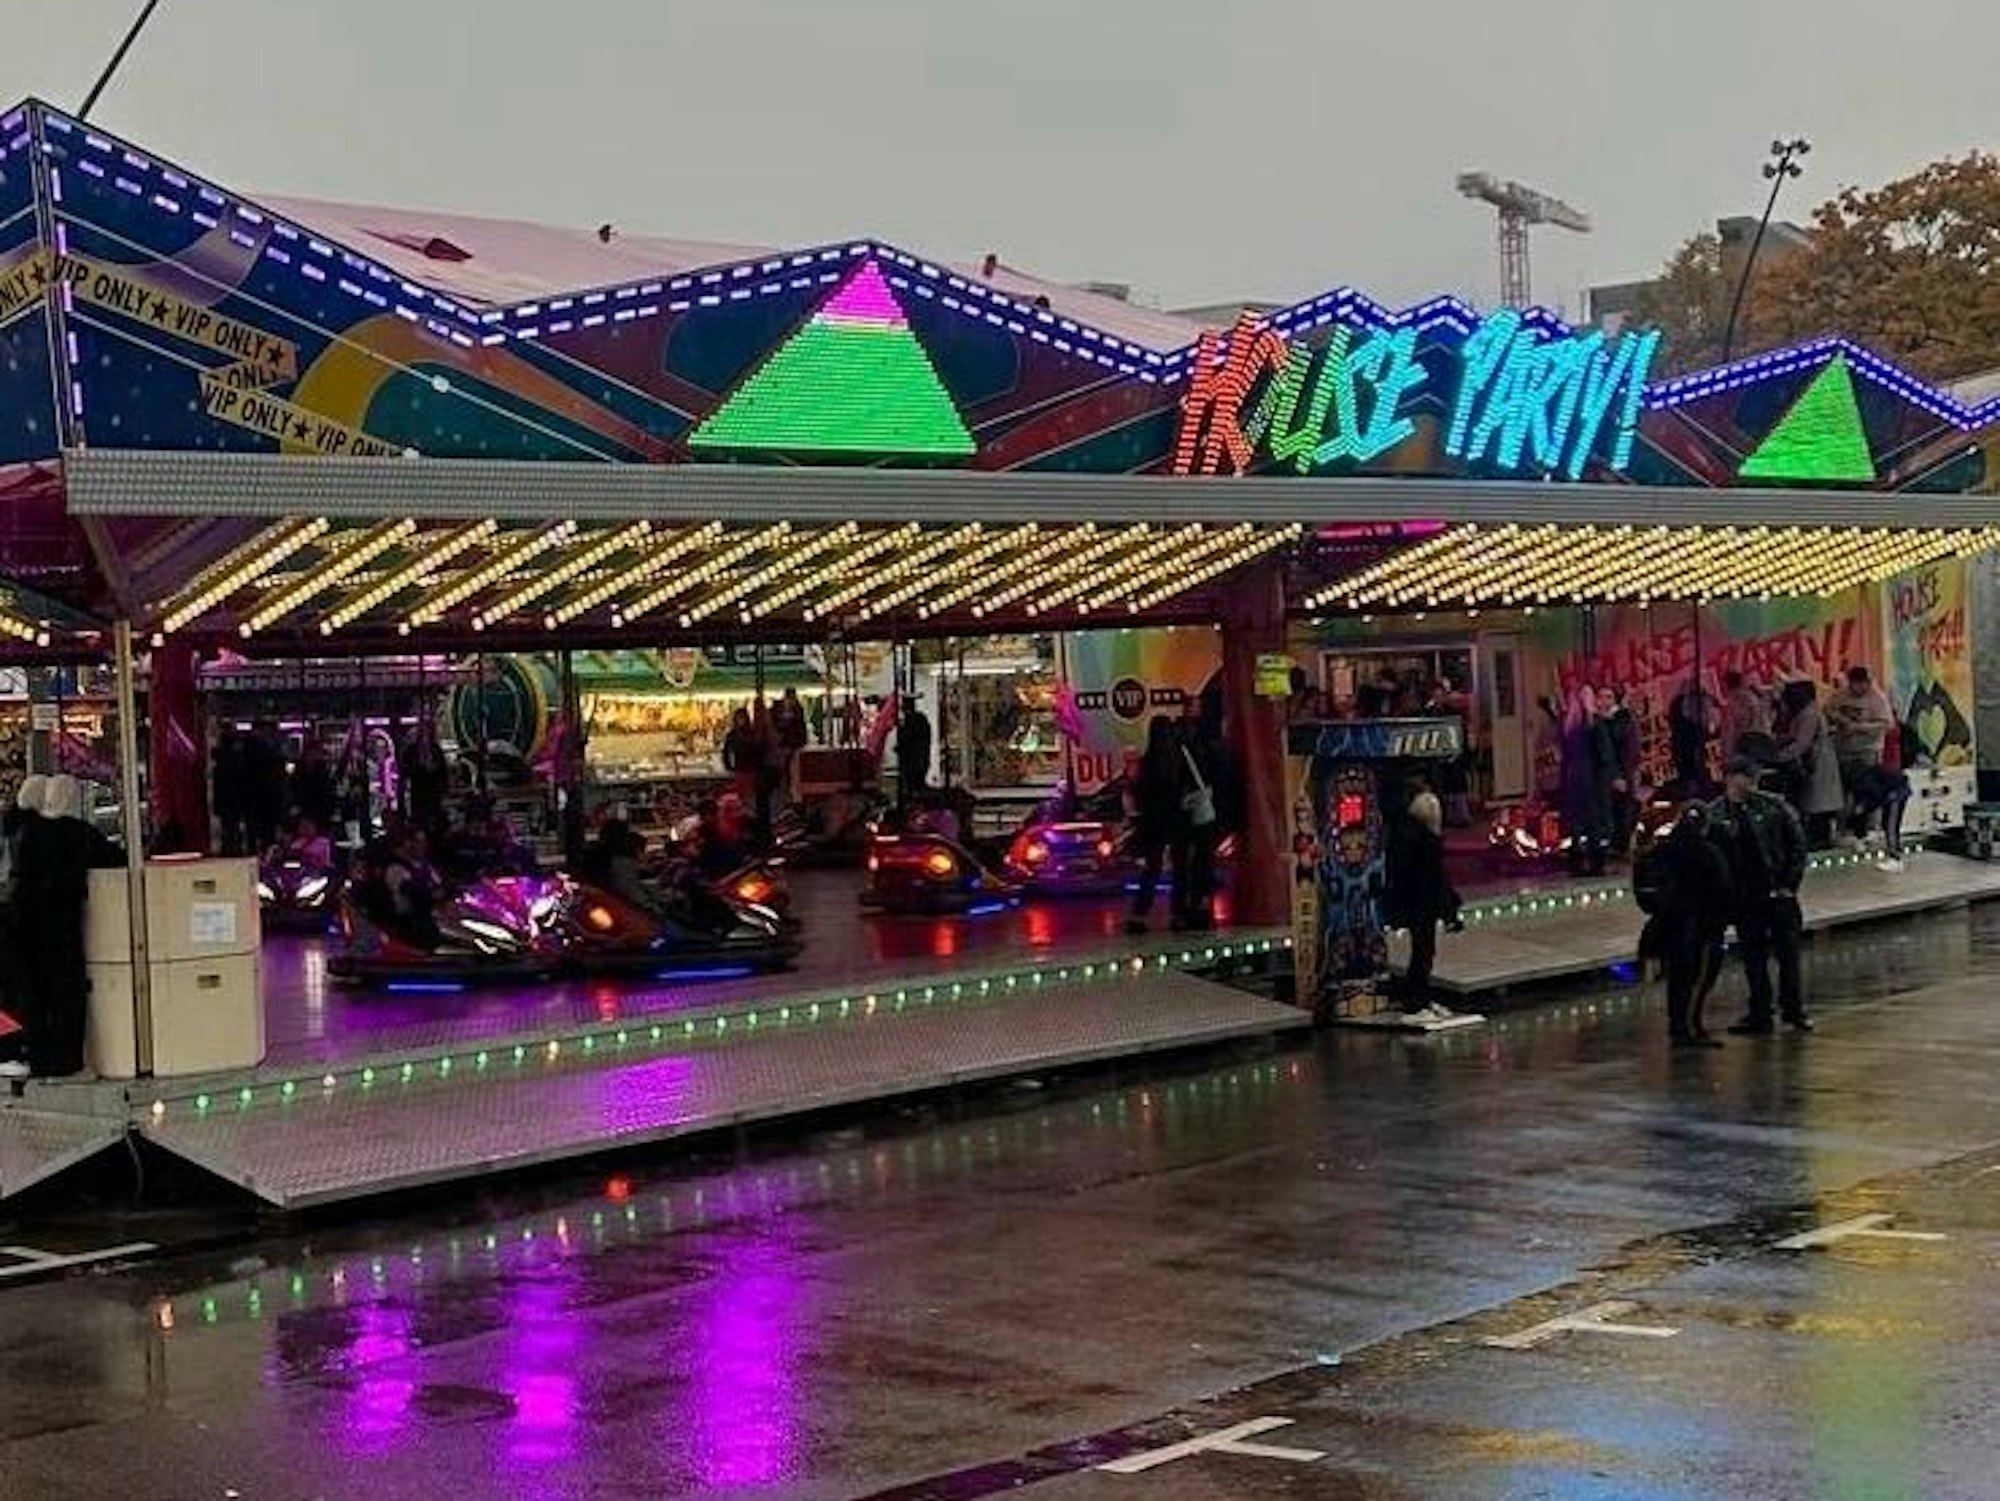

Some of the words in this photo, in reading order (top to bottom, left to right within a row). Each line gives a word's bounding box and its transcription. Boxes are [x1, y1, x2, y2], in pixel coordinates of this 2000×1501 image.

[0, 270, 29, 316] NLY
[54, 256, 88, 291] VIP
[95, 275, 151, 315] ONLY
[176, 303, 211, 338] VIP
[215, 321, 267, 360] ONLY
[206, 381, 236, 413] VIP
[243, 398, 293, 434] ONLY
[317, 423, 346, 454] VIP
[1172, 308, 1428, 478] HOUSE
[1445, 307, 1662, 480] PARTY!
